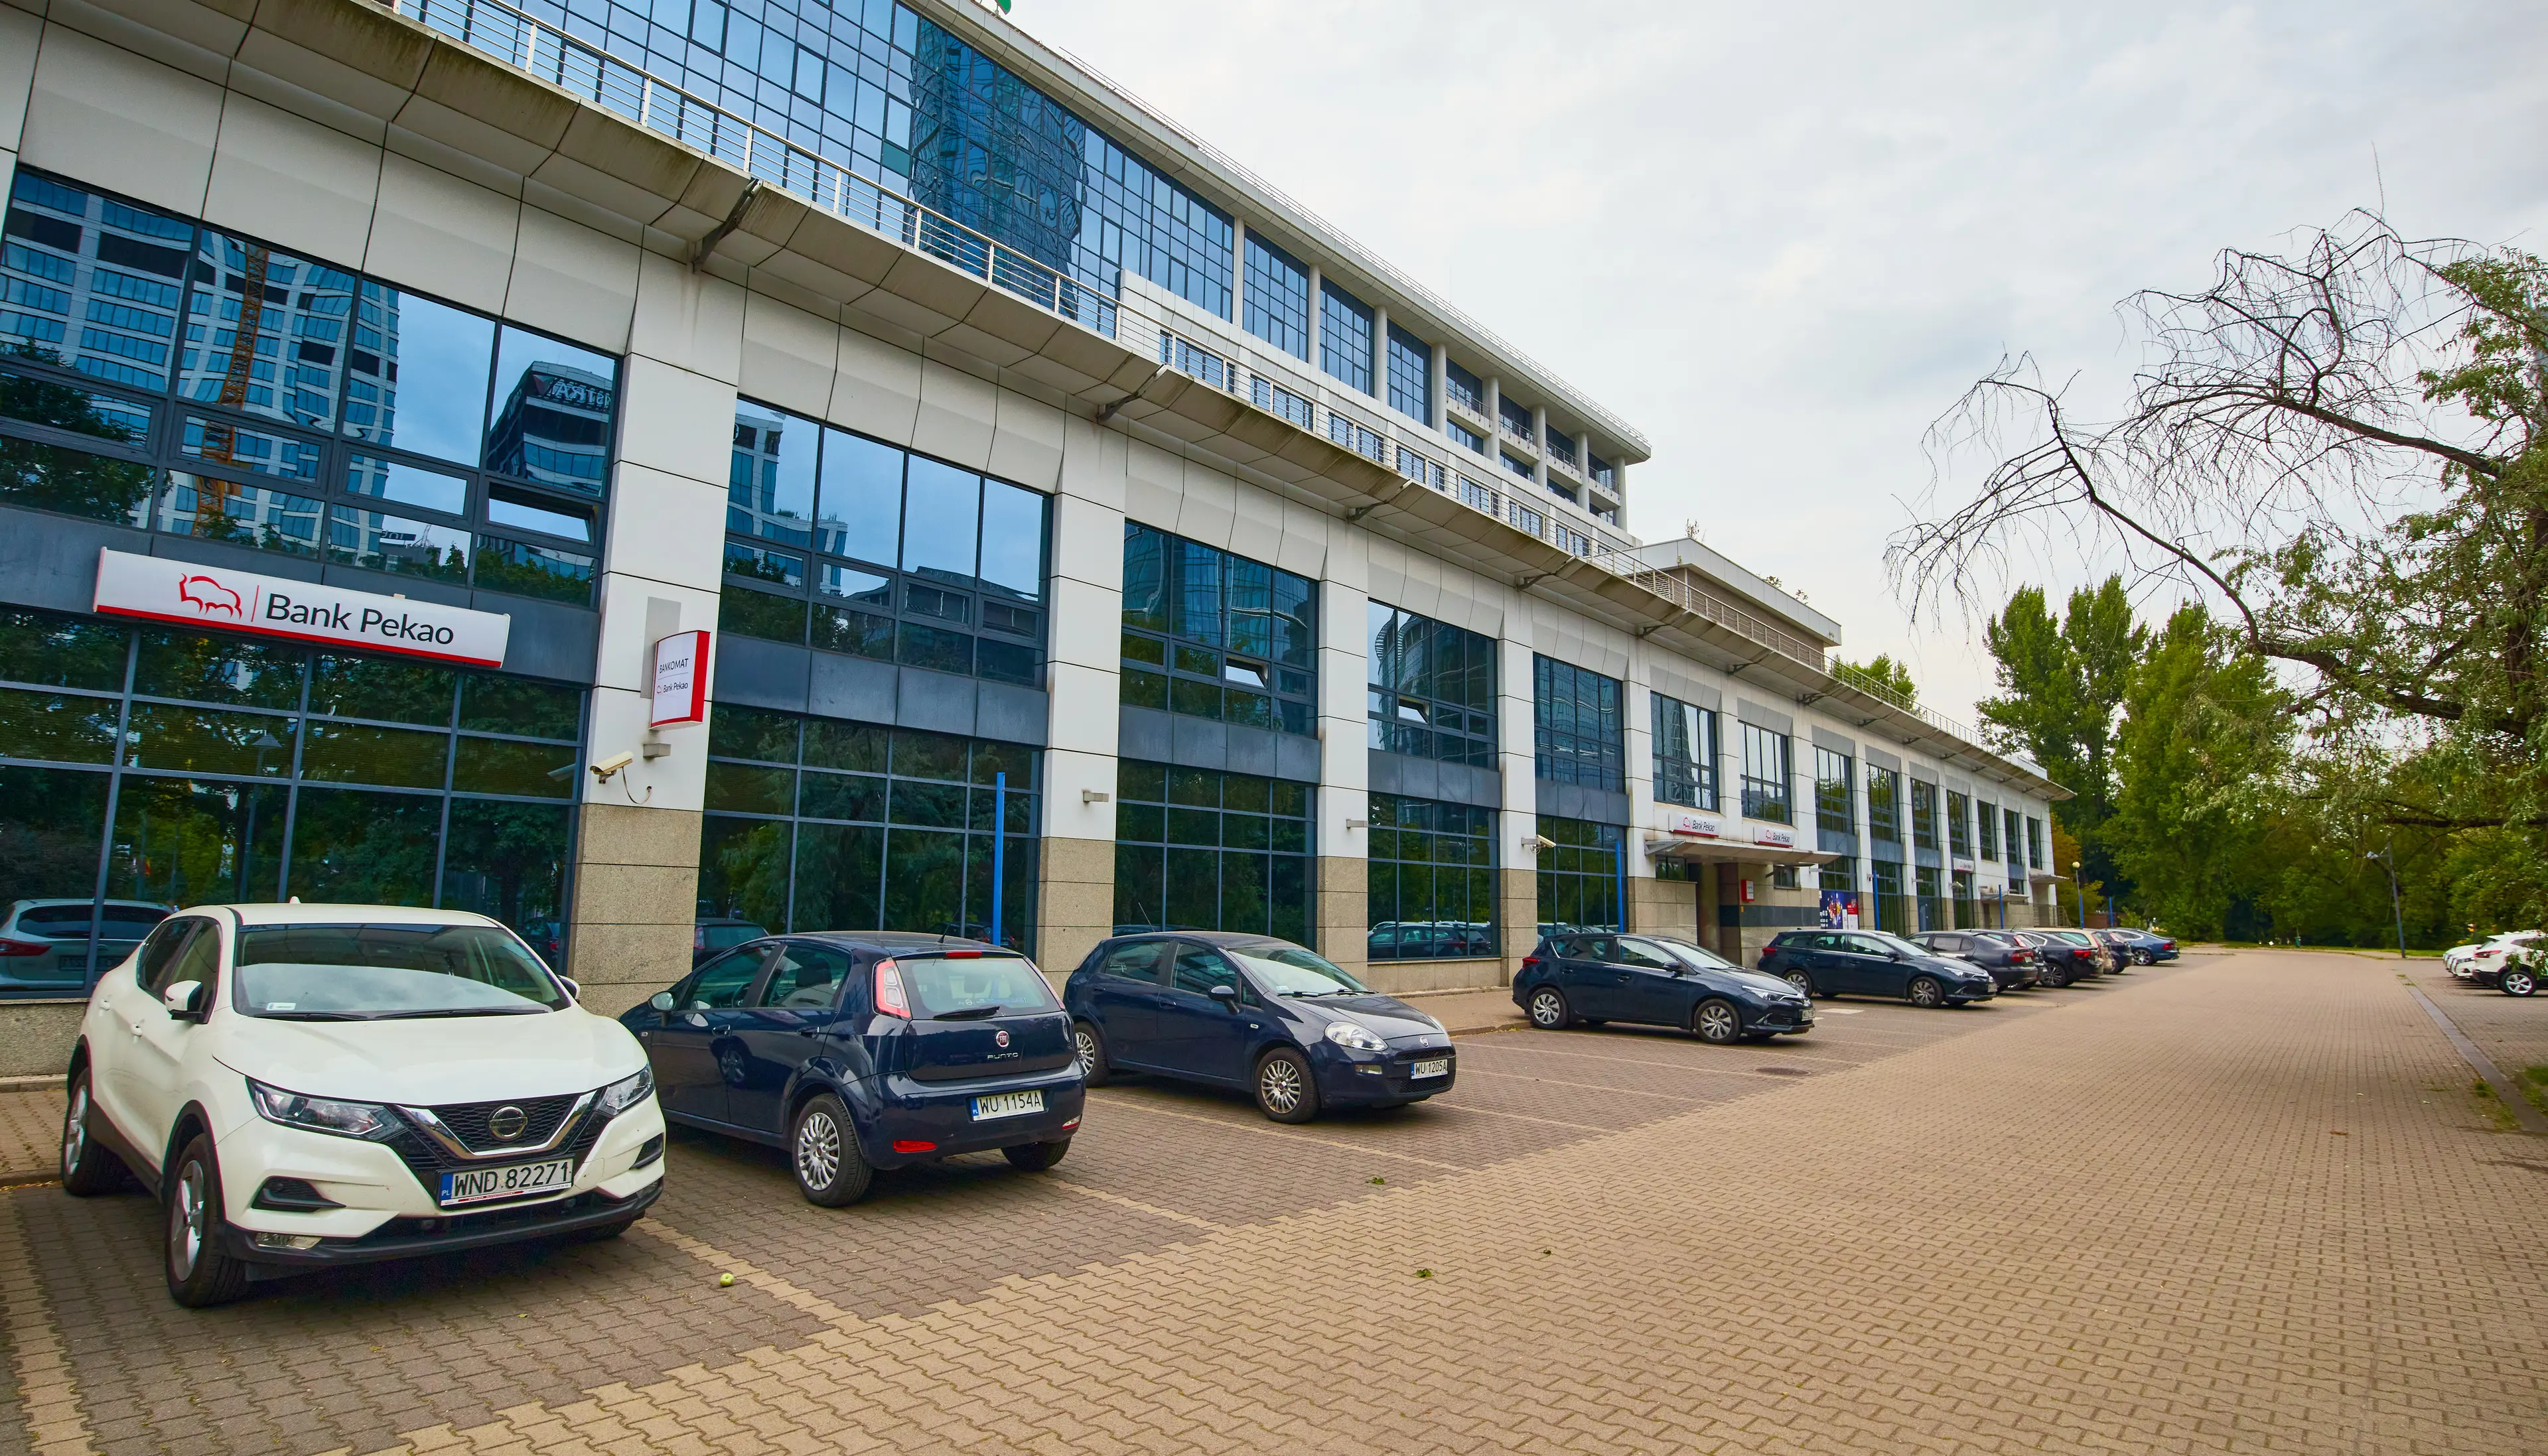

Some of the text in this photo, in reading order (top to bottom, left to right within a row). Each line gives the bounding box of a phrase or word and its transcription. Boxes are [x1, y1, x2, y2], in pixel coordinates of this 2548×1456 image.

[266, 593, 454, 645] Bank Pekao
[659, 658, 689, 673] BANKOMAT
[664, 682, 688, 693] Bank Pekao
[1692, 820, 1715, 832] Bank Pekao
[1772, 832, 1790, 843] Bank Pekao
[1416, 1061, 1446, 1075] WU 1205A
[979, 1092, 1041, 1114] WU 1154A
[455, 1161, 569, 1196] WND 82271
